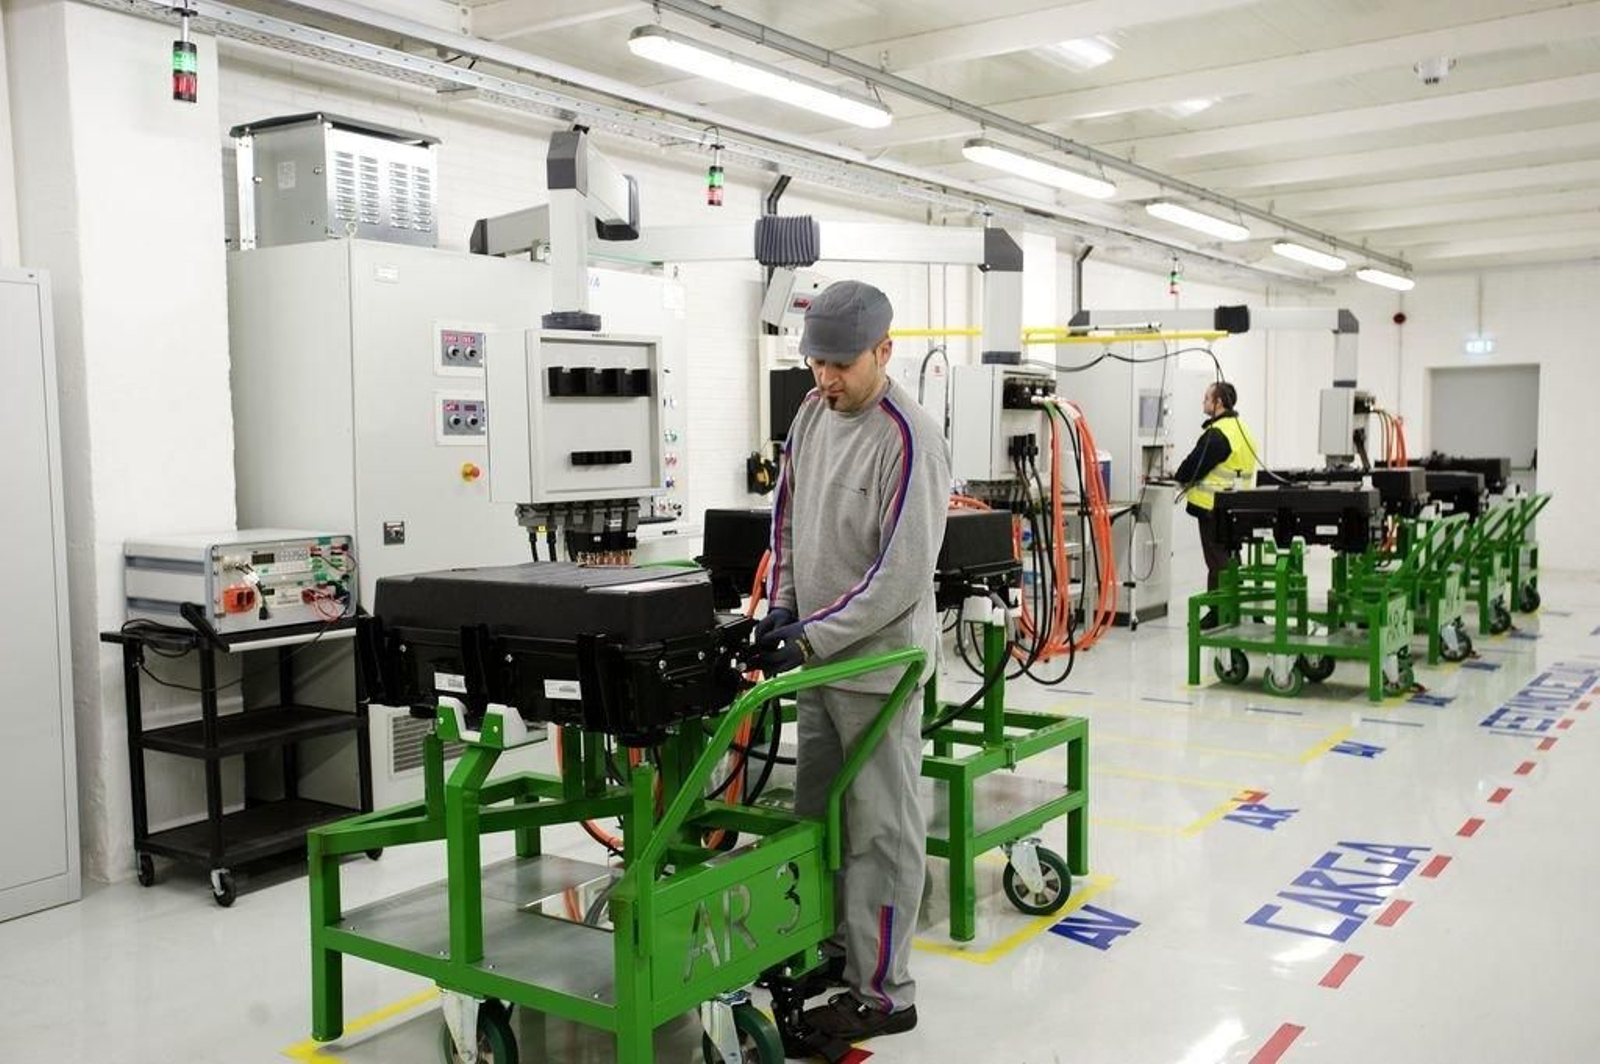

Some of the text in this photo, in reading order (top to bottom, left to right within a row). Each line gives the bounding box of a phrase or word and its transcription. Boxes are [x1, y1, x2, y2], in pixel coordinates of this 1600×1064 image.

[684, 861, 801, 982] AR 3
[1048, 904, 1142, 951] AV
[1244, 840, 1432, 943] CARGA
